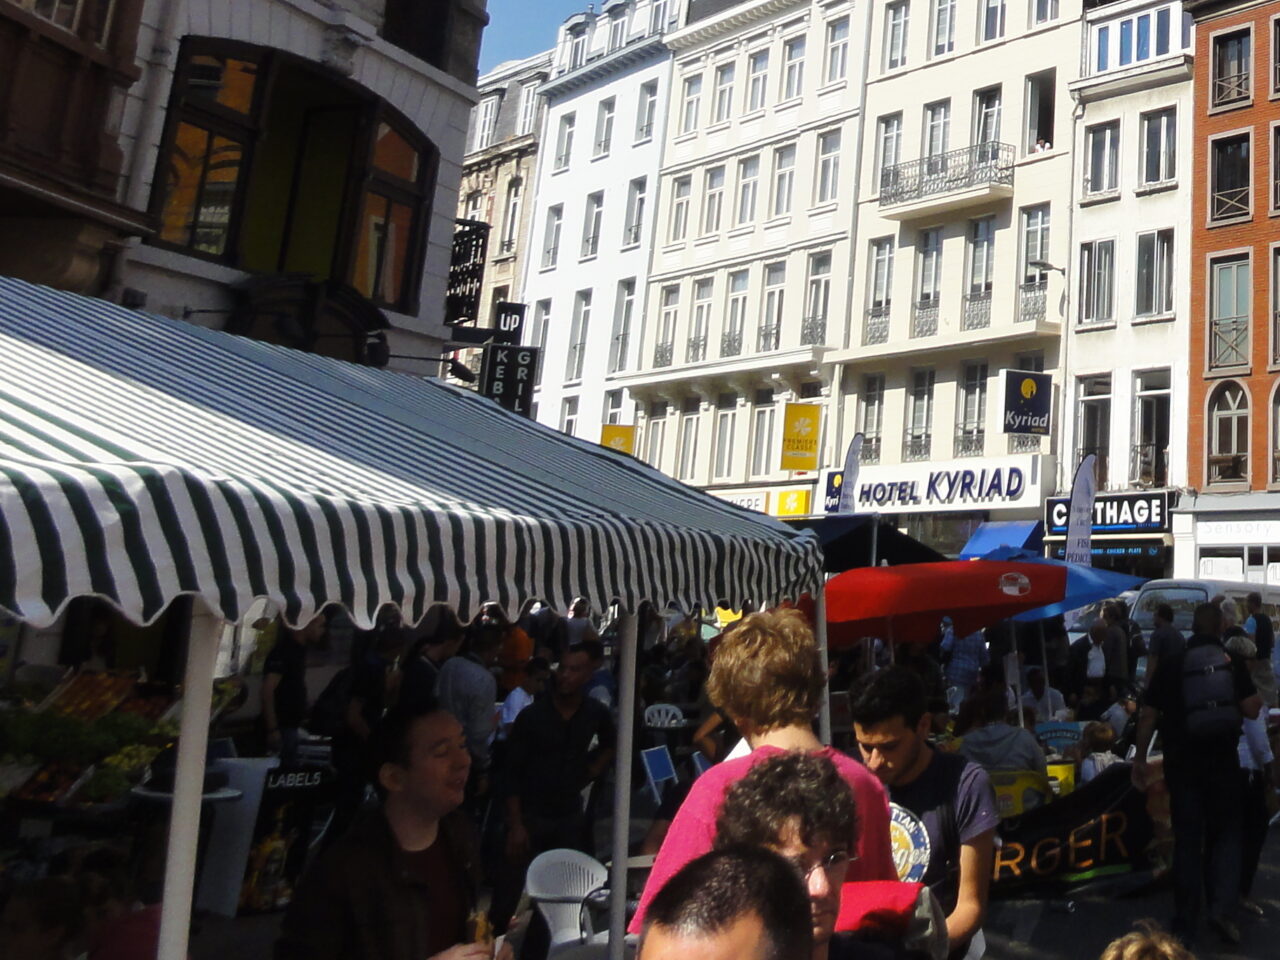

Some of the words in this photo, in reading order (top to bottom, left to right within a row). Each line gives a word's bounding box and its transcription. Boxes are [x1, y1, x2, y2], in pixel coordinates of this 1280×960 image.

[1005, 410, 1049, 429] Kyriad
[859, 481, 919, 505] HOTEL
[926, 467, 1024, 502] KYRIAD
[825, 494, 840, 508] Kyri
[1052, 499, 1161, 526] CTHAGE
[1203, 521, 1273, 537] Sensory
[892, 808, 917, 834] TTAN
[993, 810, 1129, 882] RGER
